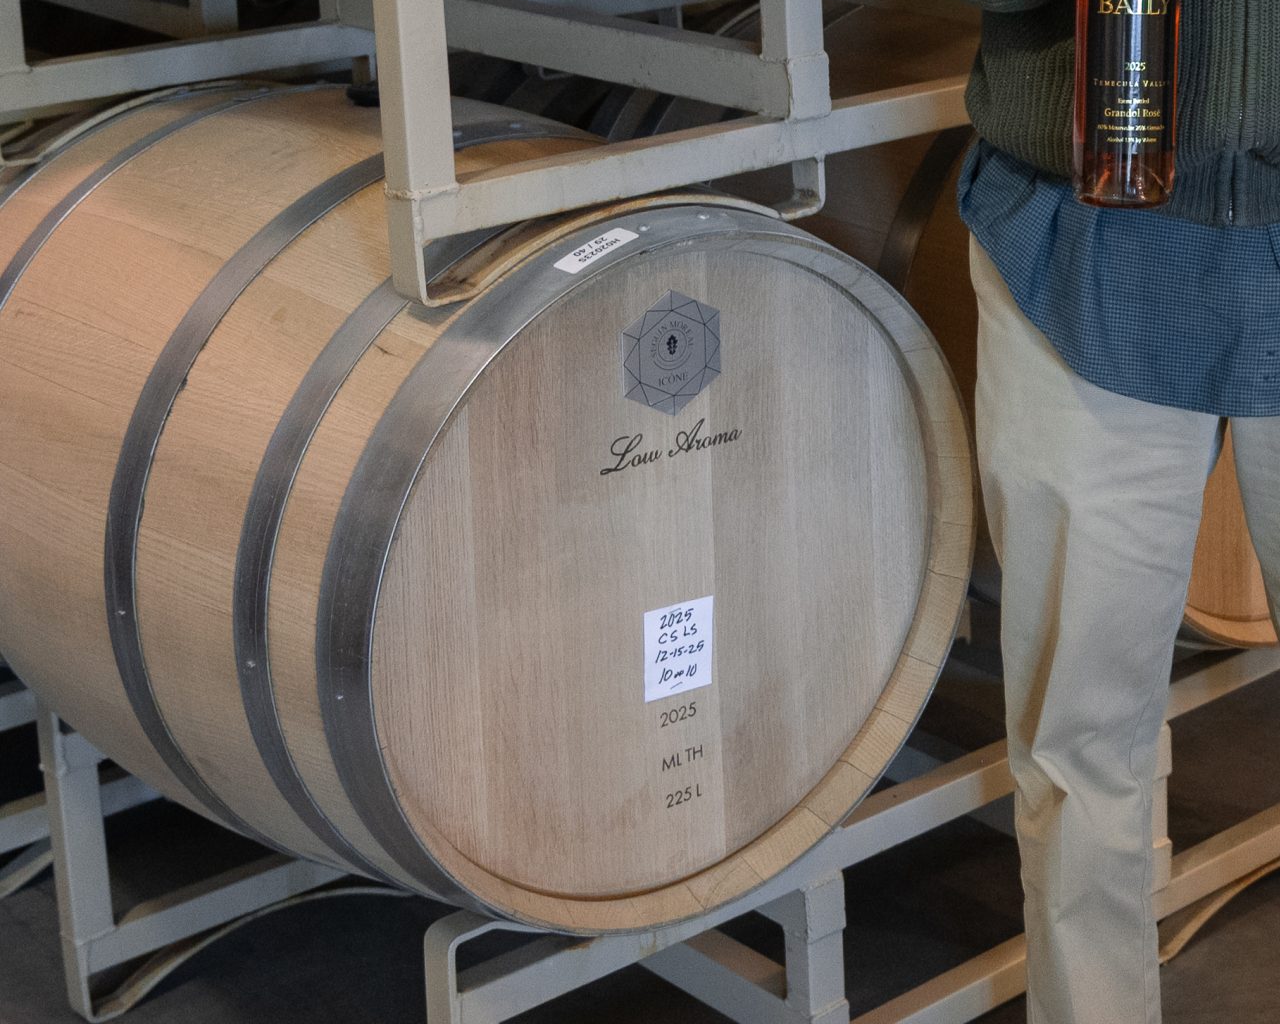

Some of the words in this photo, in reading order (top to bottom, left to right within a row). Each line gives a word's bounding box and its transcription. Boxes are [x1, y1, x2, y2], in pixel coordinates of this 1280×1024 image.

[1124, 62, 1147, 72] 2025
[1104, 107, 1140, 118] Grandol
[600, 433, 663, 475] Low
[668, 418, 743, 458] Aroma
[659, 607, 695, 629] 2025
[660, 701, 697, 728] 2025
[661, 752, 682, 772] ML
[685, 744, 704, 762] TH
[665, 786, 692, 809] 225
[697, 783, 703, 797] L
